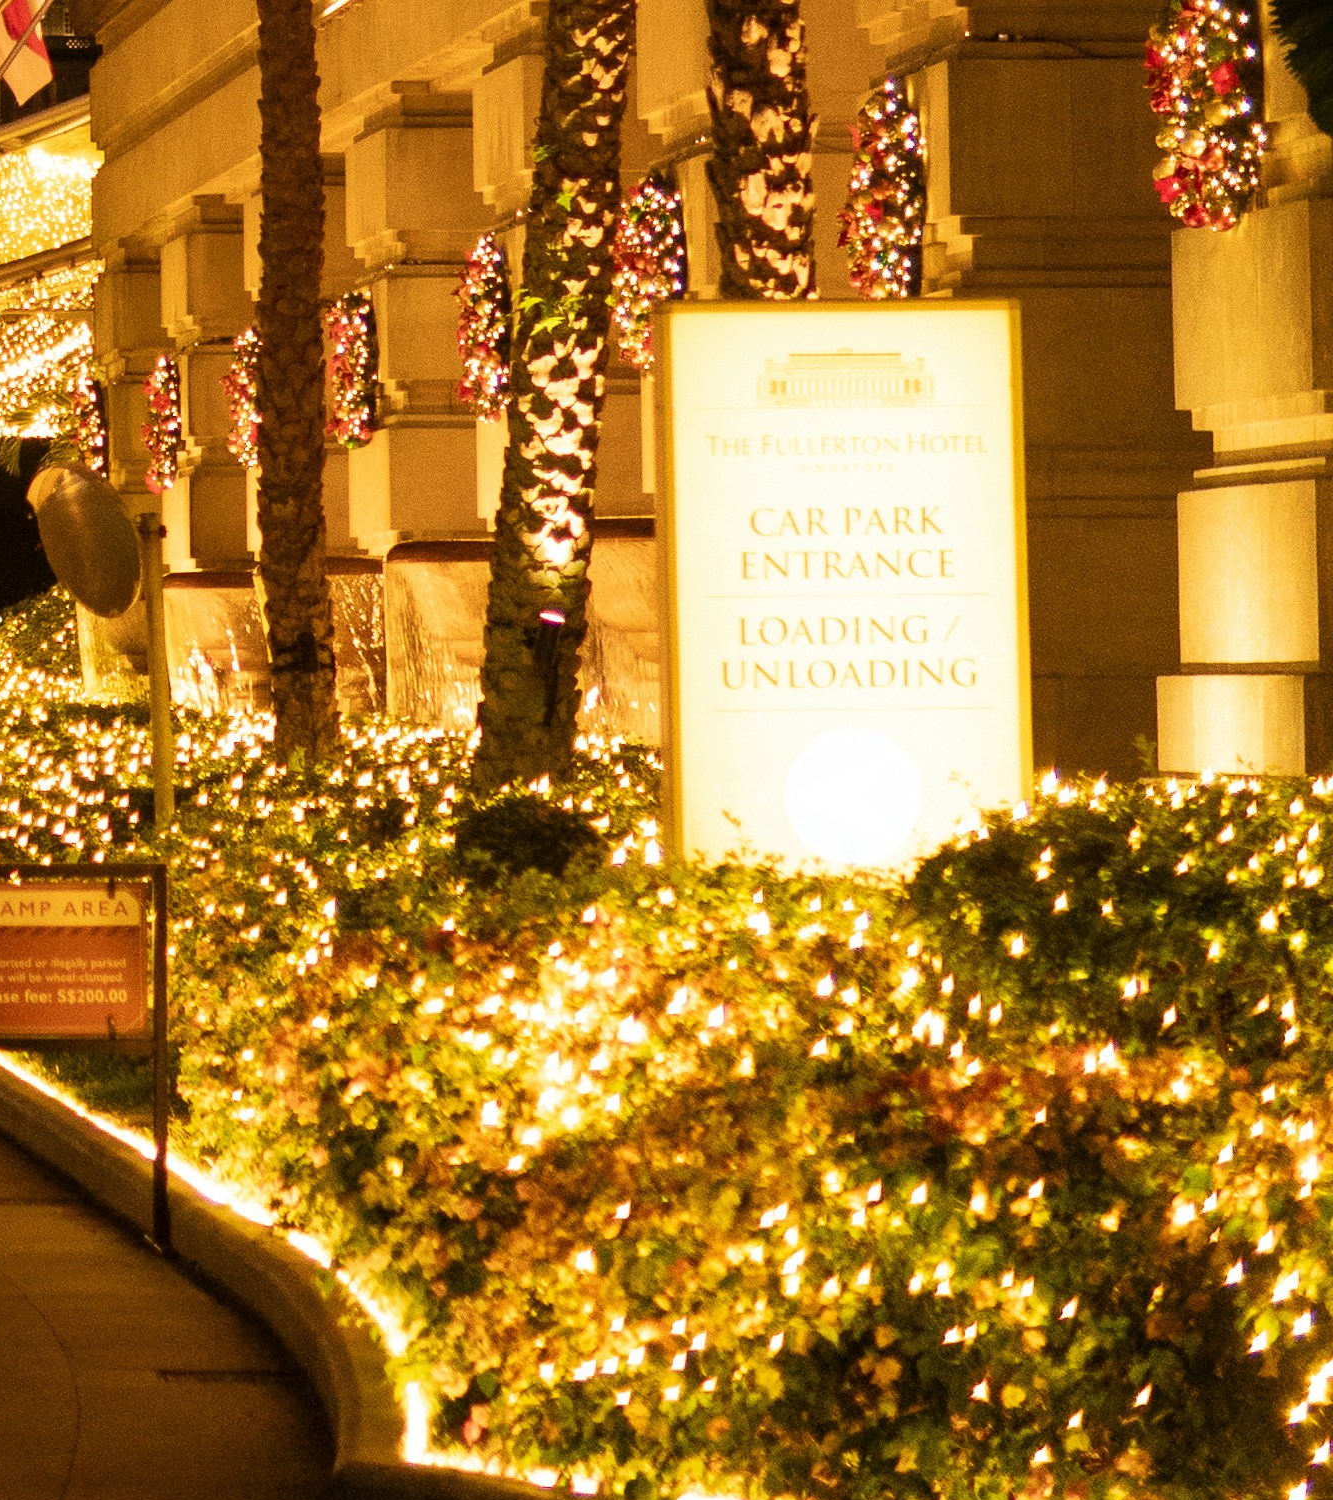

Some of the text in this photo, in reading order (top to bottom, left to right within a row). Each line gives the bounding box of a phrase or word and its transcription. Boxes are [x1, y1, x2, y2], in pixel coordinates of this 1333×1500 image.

[705, 432, 988, 456] THE FULLERTON HOTEL
[799, 462, 895, 473] SINGAPORE
[748, 505, 945, 537] CAR PARK
[740, 549, 955, 580] ENTRANCE
[737, 615, 929, 647] LOADING
[719, 658, 978, 690] UNLOADING
[62, 898, 130, 917] AREA
[25, 988, 53, 1004] fee:
[57, 988, 129, 1005] S$200.00
